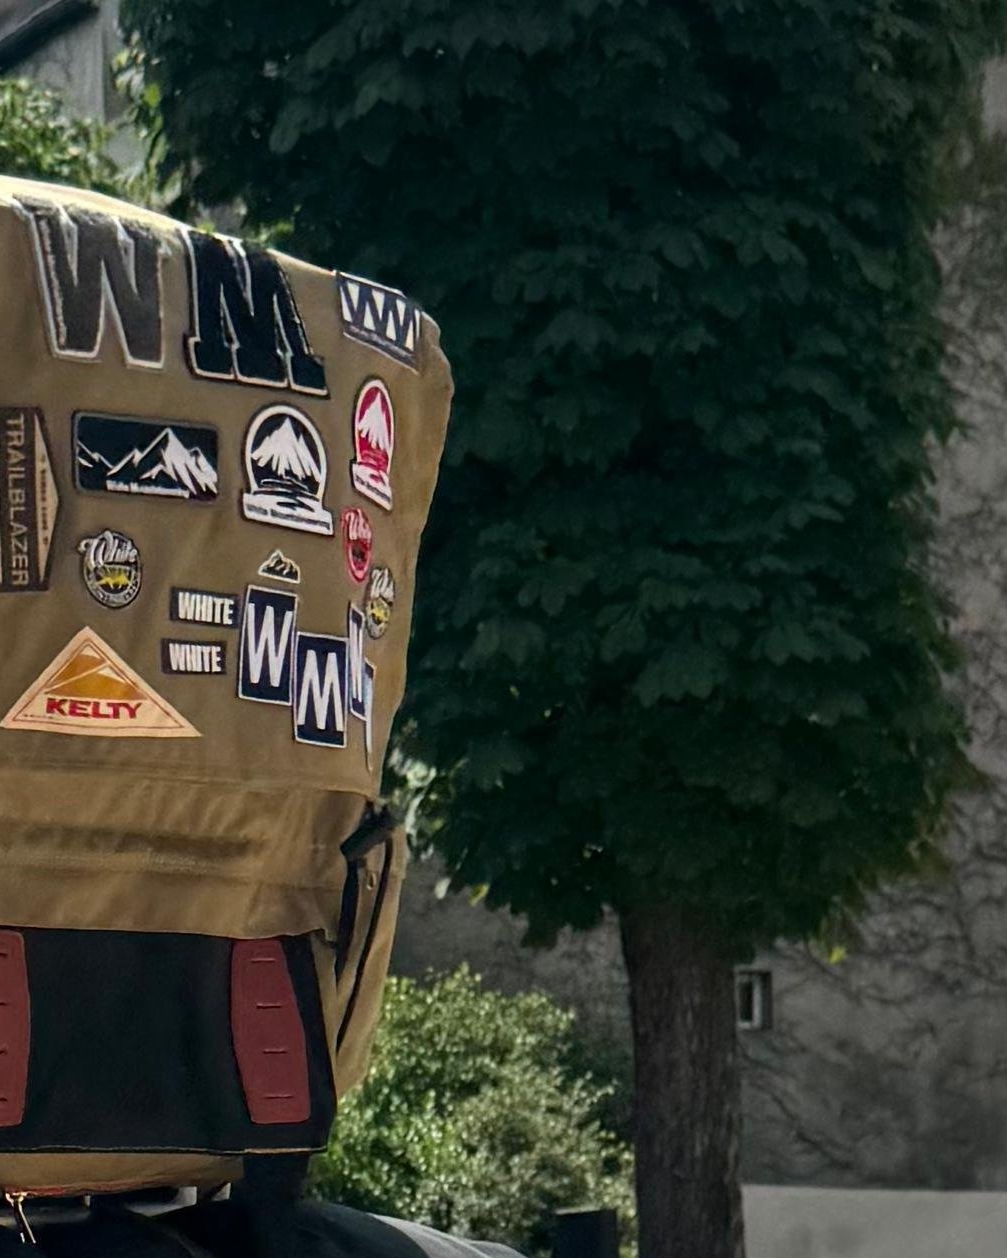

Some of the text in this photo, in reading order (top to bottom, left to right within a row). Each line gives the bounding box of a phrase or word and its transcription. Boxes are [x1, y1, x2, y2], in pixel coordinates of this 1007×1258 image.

[6, 415, 31, 587] TRAILBLAZER
[177, 591, 236, 625] WHITE
[168, 642, 223, 673] WHITE
[247, 602, 294, 688] W
[45, 697, 143, 719] KELTY
[297, 648, 345, 732] M
